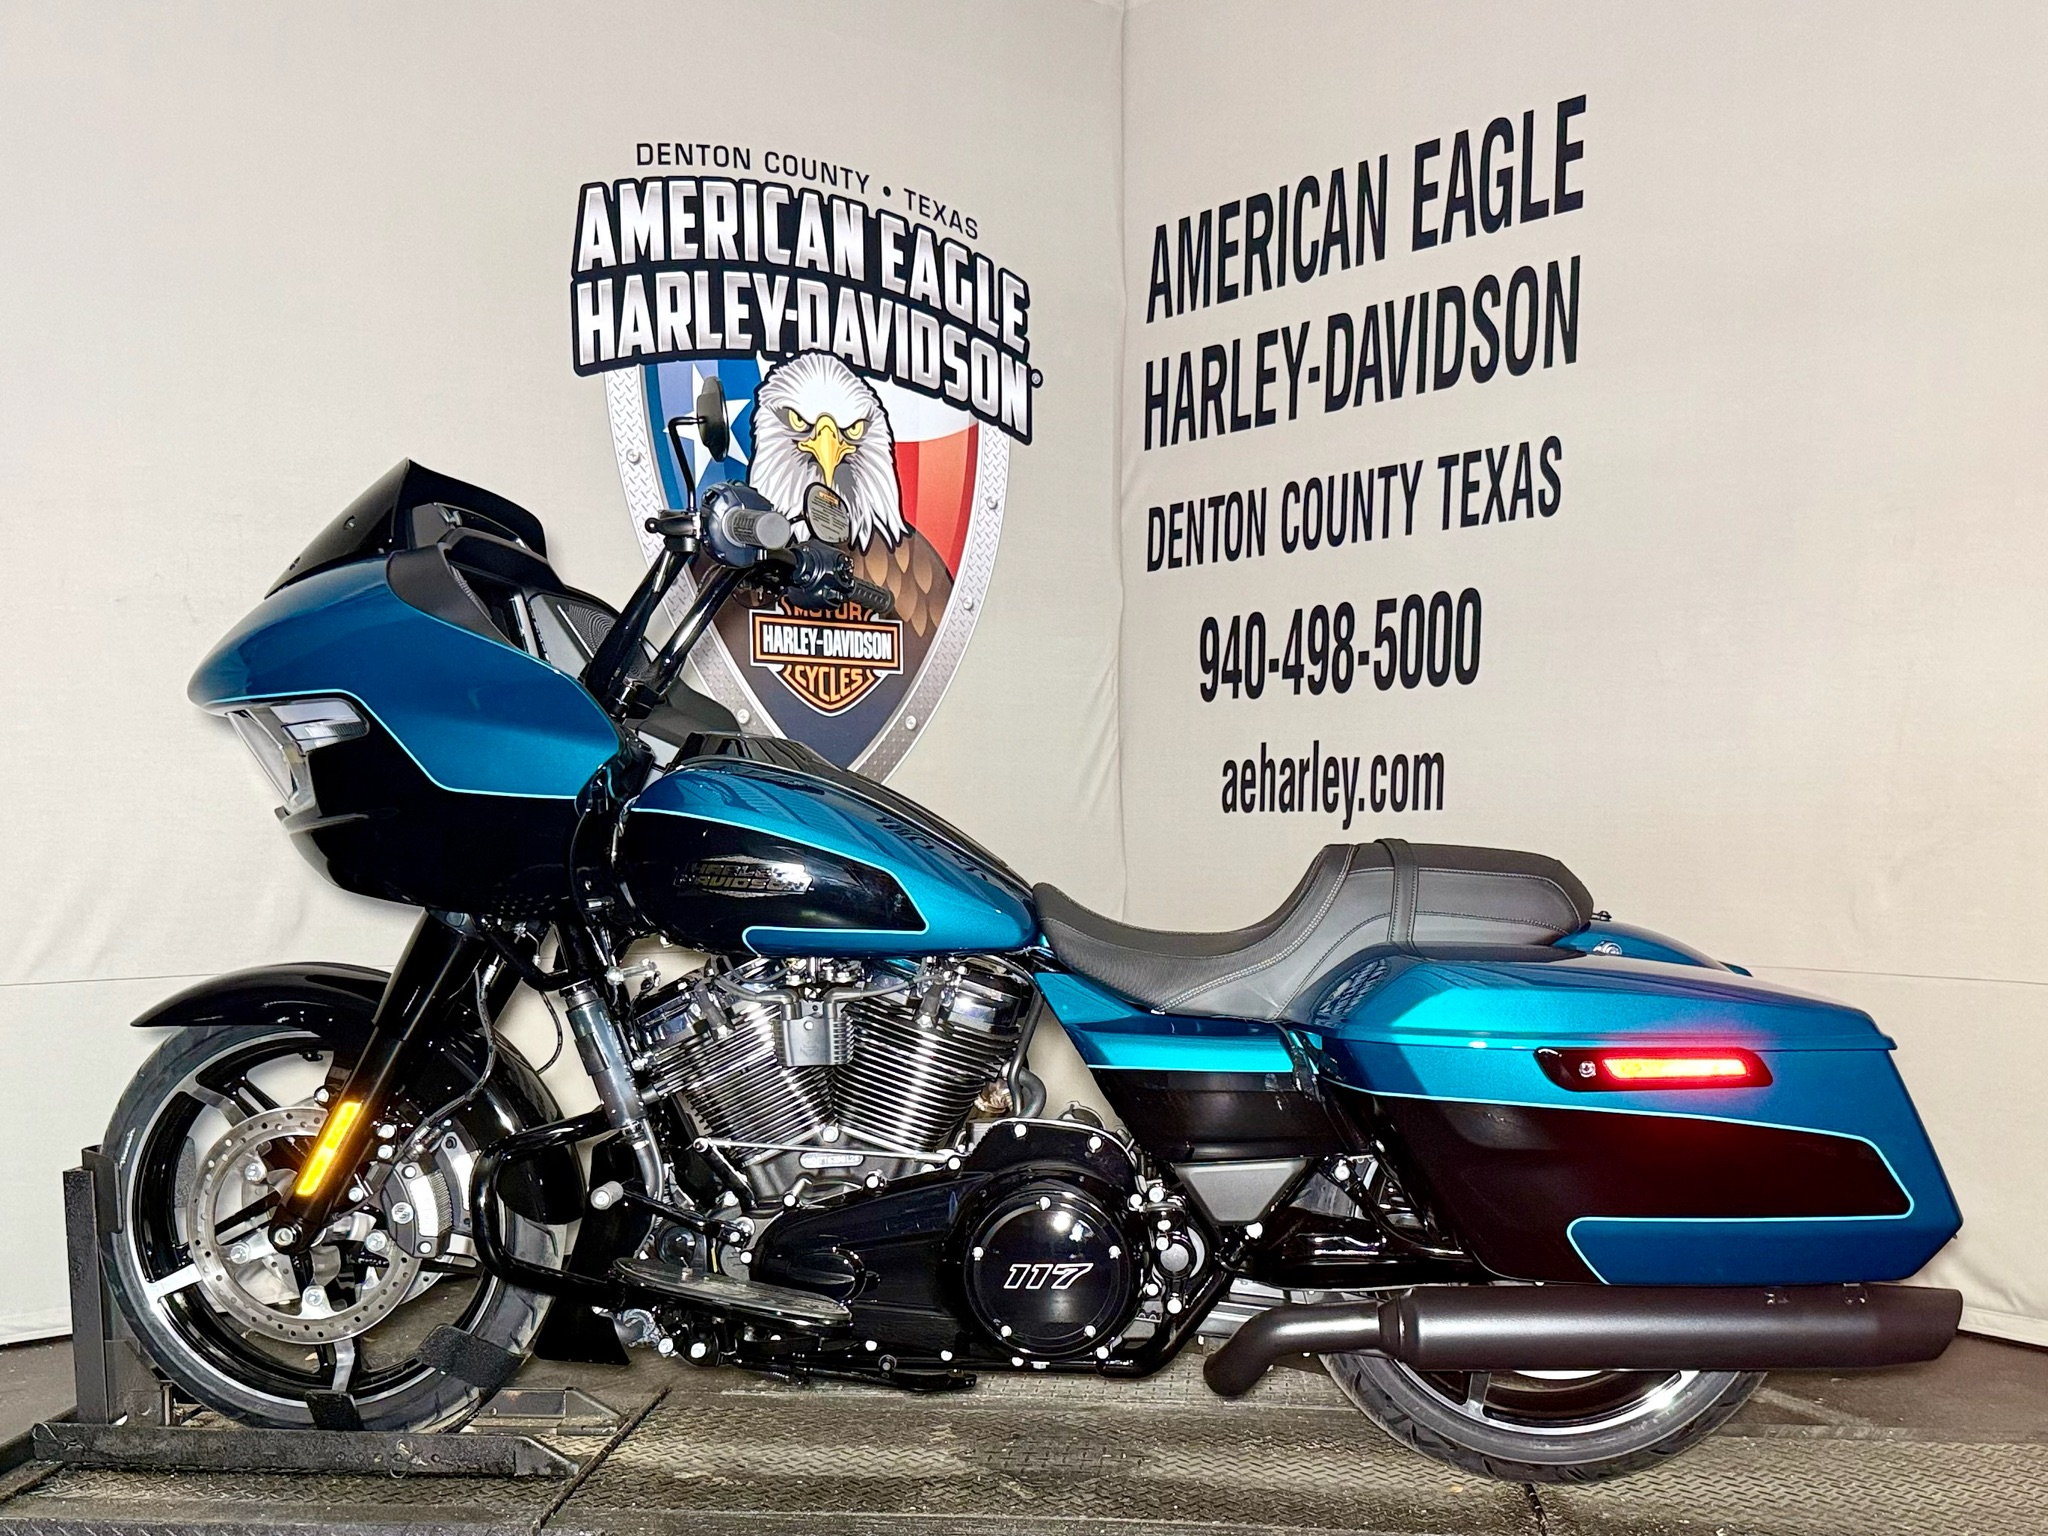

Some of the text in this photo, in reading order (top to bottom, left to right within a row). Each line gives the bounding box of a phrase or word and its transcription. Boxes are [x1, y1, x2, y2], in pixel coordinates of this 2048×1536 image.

[636, 142, 979, 241] DENTON COUNTY TEXAS
[1146, 94, 1587, 324] AMERICAN EAGLE
[576, 178, 1029, 352] AMERICAN EAGLE
[576, 268, 1030, 437] HARLEY-DAVIDSON
[1144, 254, 1581, 452] HARLEY-DAVIDSON
[1146, 435, 1563, 573] DENTON COUNTY TEXAS
[762, 624, 893, 661] HARLEY-DAVIDSON
[794, 664, 863, 703] CYCLES
[1199, 587, 1482, 703] 940-498-5000
[1221, 740, 1445, 831] aeharley.com
[1003, 1262, 1094, 1290] 117
